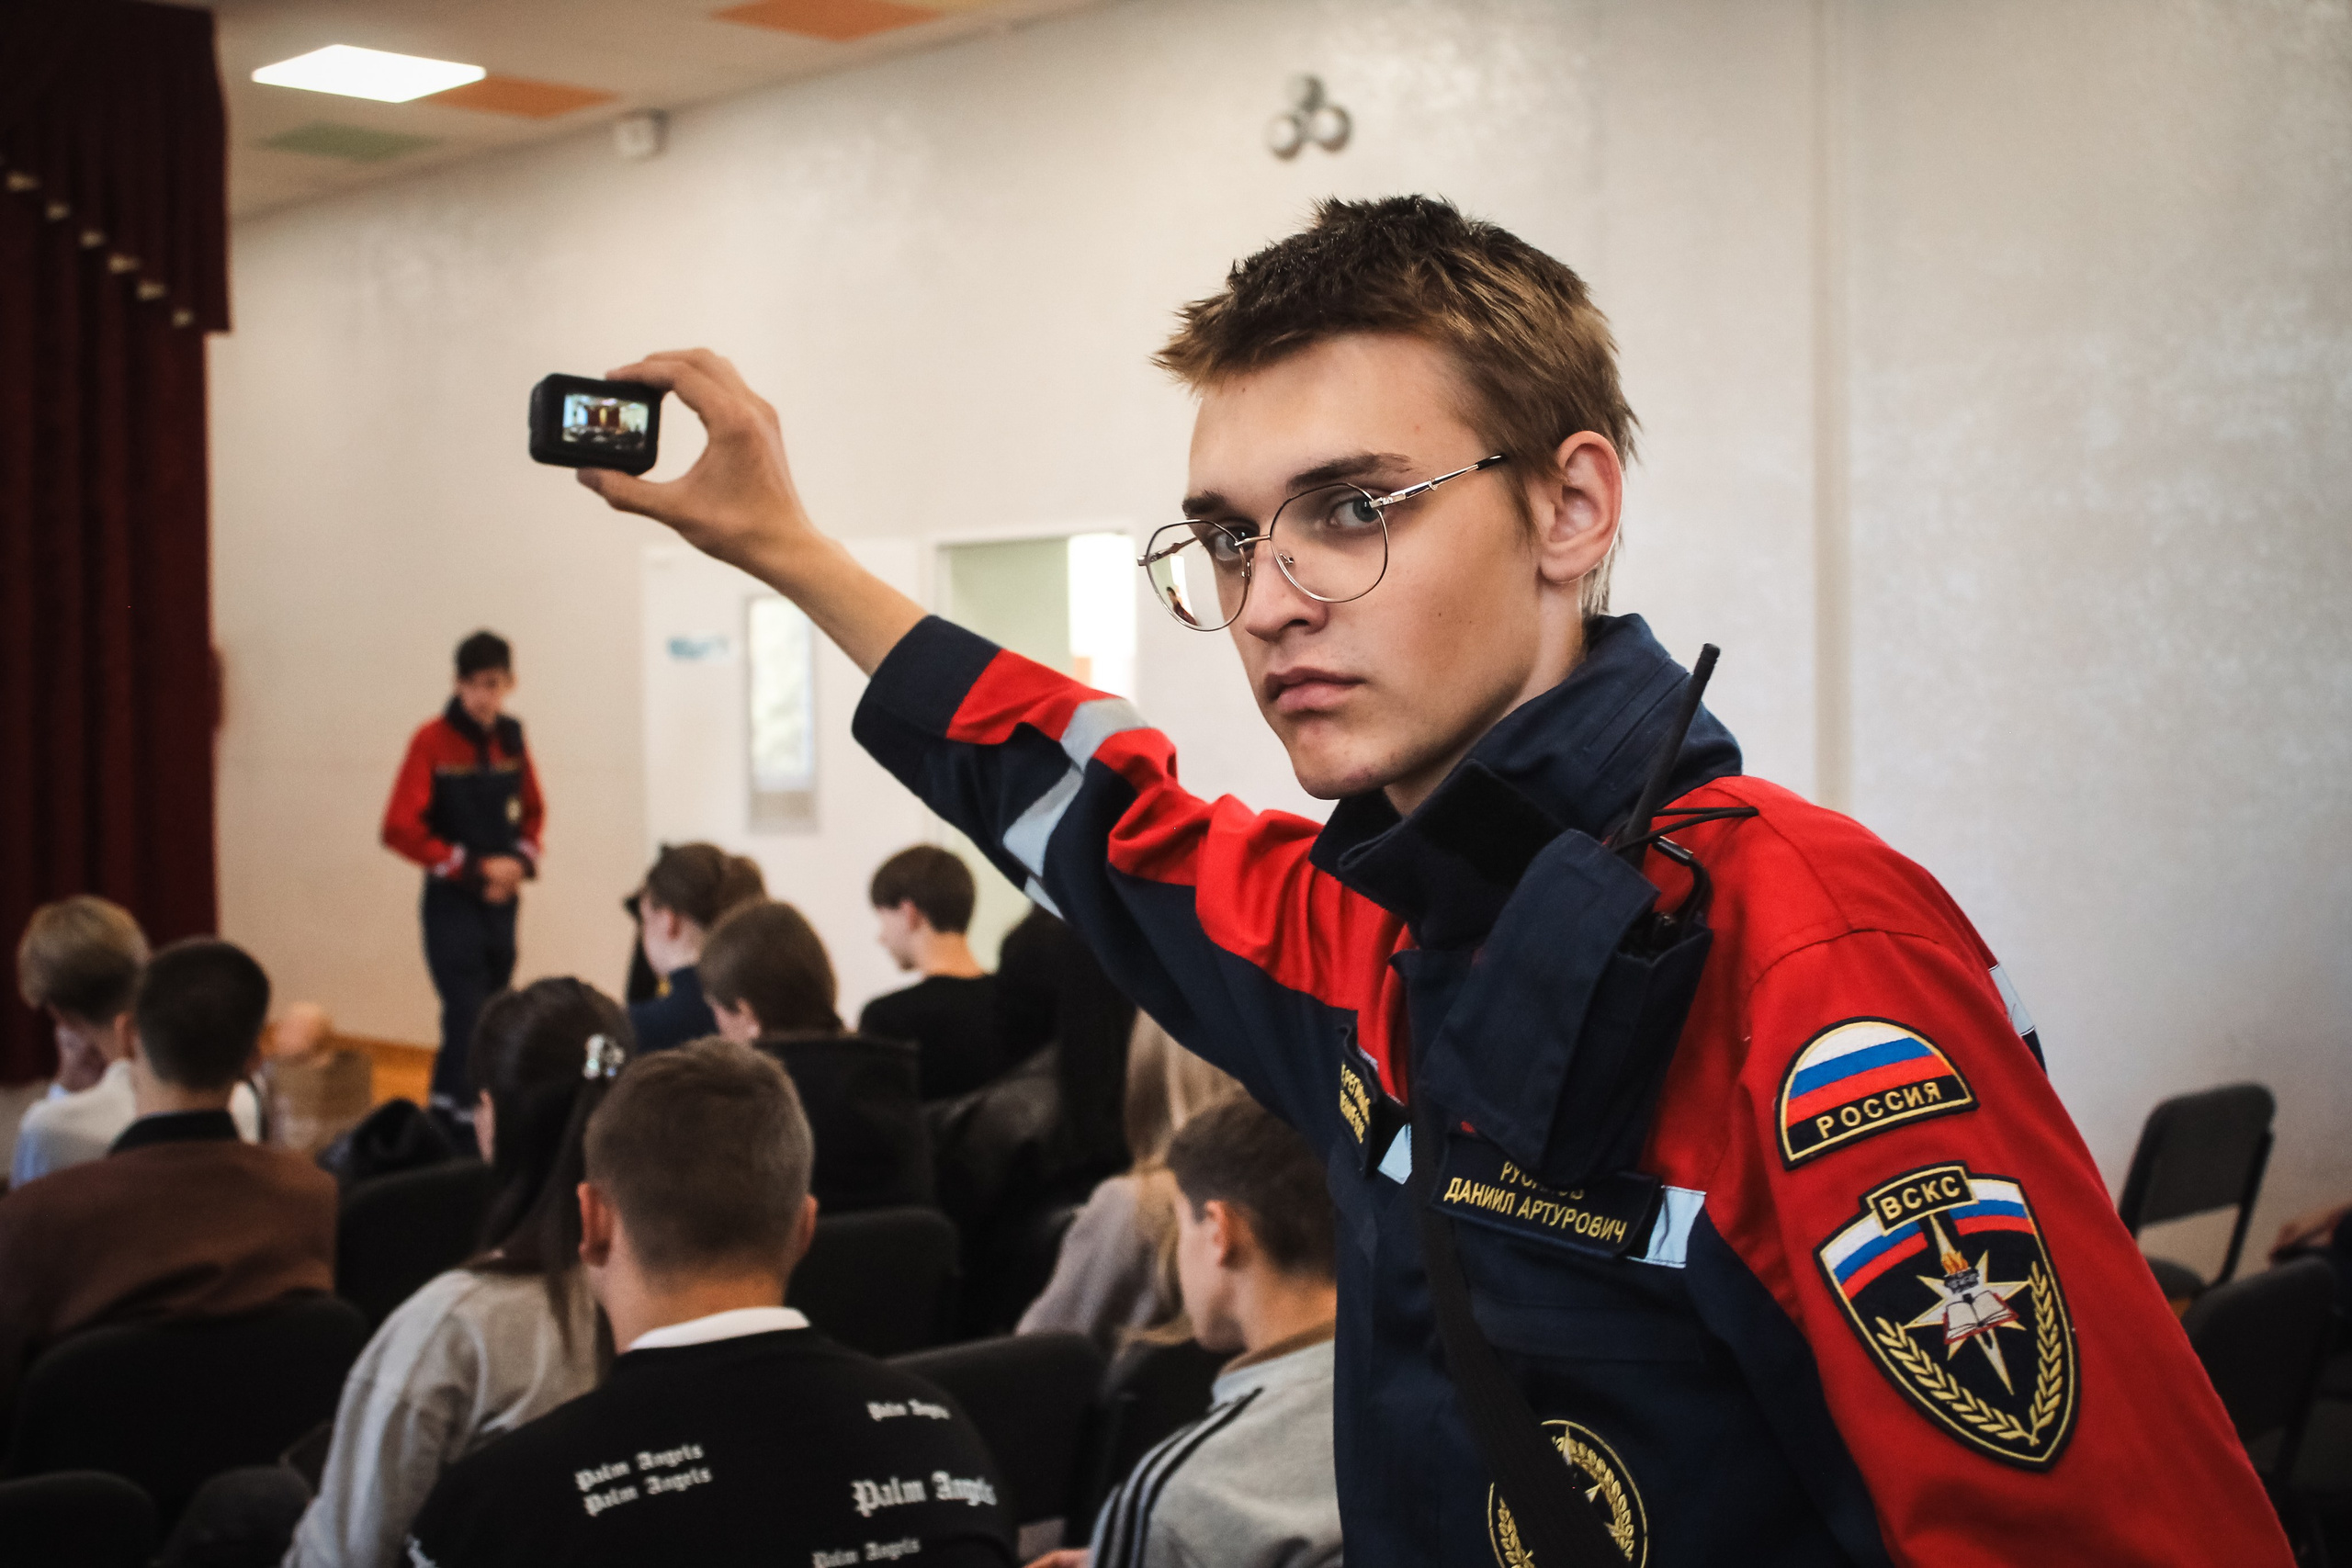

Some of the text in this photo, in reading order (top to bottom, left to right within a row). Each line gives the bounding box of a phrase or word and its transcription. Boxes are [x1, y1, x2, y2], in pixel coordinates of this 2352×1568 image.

[1815, 1081, 1942, 1139] РОССИЯ
[1443, 1177, 1628, 1244] ДАНИИЛ АРТУРОВИЧ
[1879, 1176, 1961, 1221] ВСКС
[575, 1461, 630, 1492] Palm
[851, 1475, 927, 1517] Palm
[583, 1486, 639, 1517] Palm
